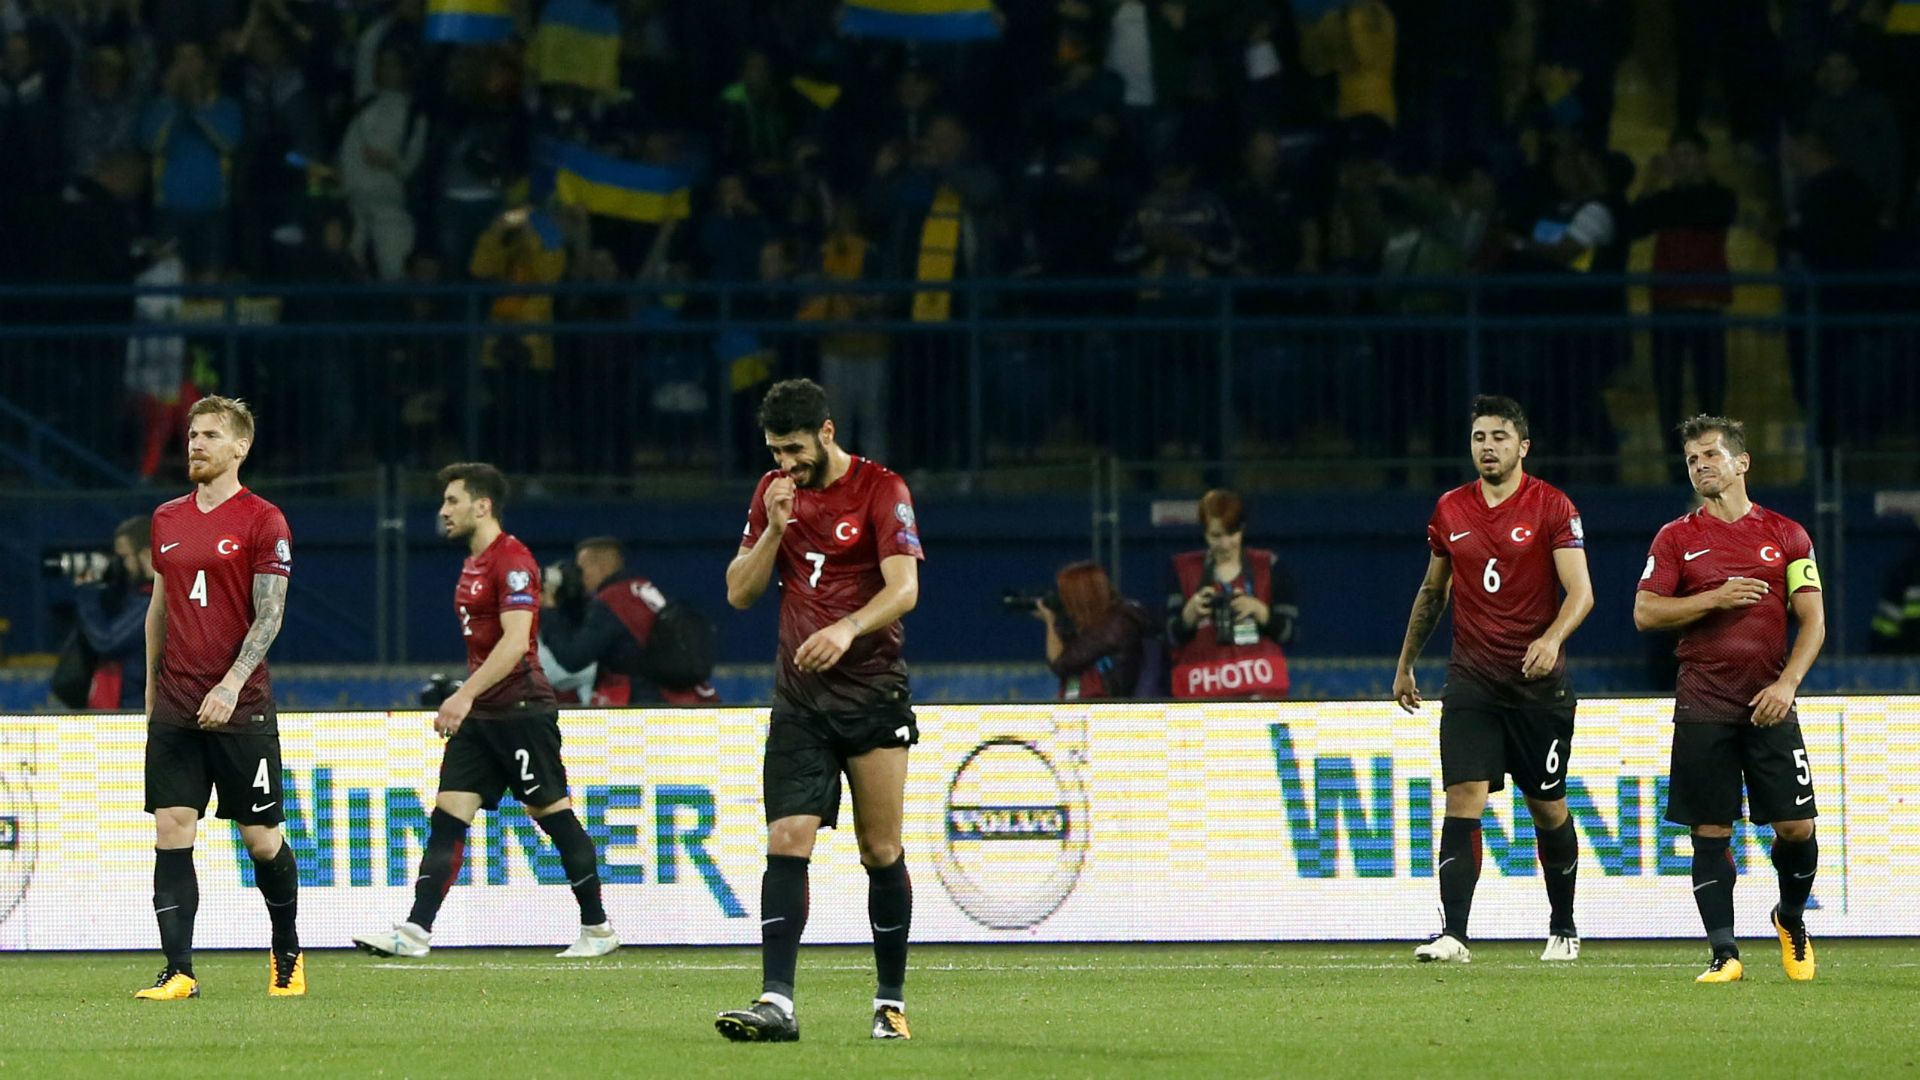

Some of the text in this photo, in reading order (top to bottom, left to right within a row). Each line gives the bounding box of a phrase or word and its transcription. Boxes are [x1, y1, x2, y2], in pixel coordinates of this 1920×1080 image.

[805, 552, 826, 588] 7
[1483, 558, 1500, 593] 6
[1803, 565, 1816, 581] C
[189, 569, 208, 607] 4
[1188, 658, 1273, 694] PHOTO
[515, 748, 534, 781] 2
[1546, 739, 1559, 773] 6
[1793, 748, 1811, 786] 5
[252, 757, 271, 795] 4
[951, 809, 1064, 833] VOLVO
